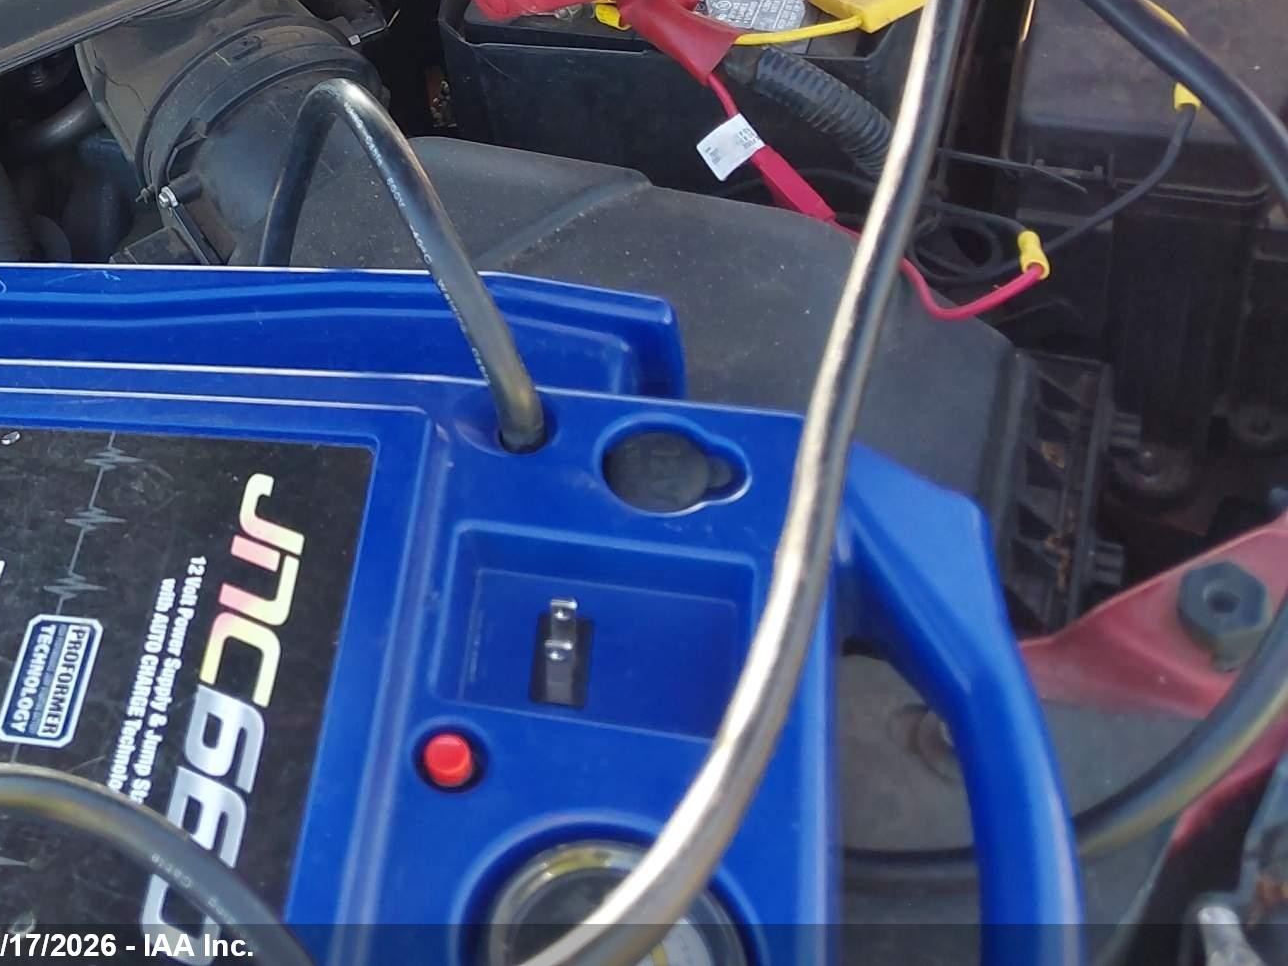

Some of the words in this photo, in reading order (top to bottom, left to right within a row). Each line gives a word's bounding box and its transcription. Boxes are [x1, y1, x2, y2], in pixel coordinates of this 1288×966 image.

[187, 555, 207, 575] 12
[155, 578, 176, 613] with
[179, 576, 203, 607] Volt
[144, 612, 169, 654] AUTO
[167, 607, 195, 657] Power
[9, 623, 58, 734] TECHNOLOGY
[41, 627, 87, 735] PROFORMER
[127, 654, 159, 717] CHARGE
[149, 657, 182, 712] Supply
[147, 713, 168, 728] &
[107, 718, 143, 792] Technolo
[133, 729, 163, 777] Jump
